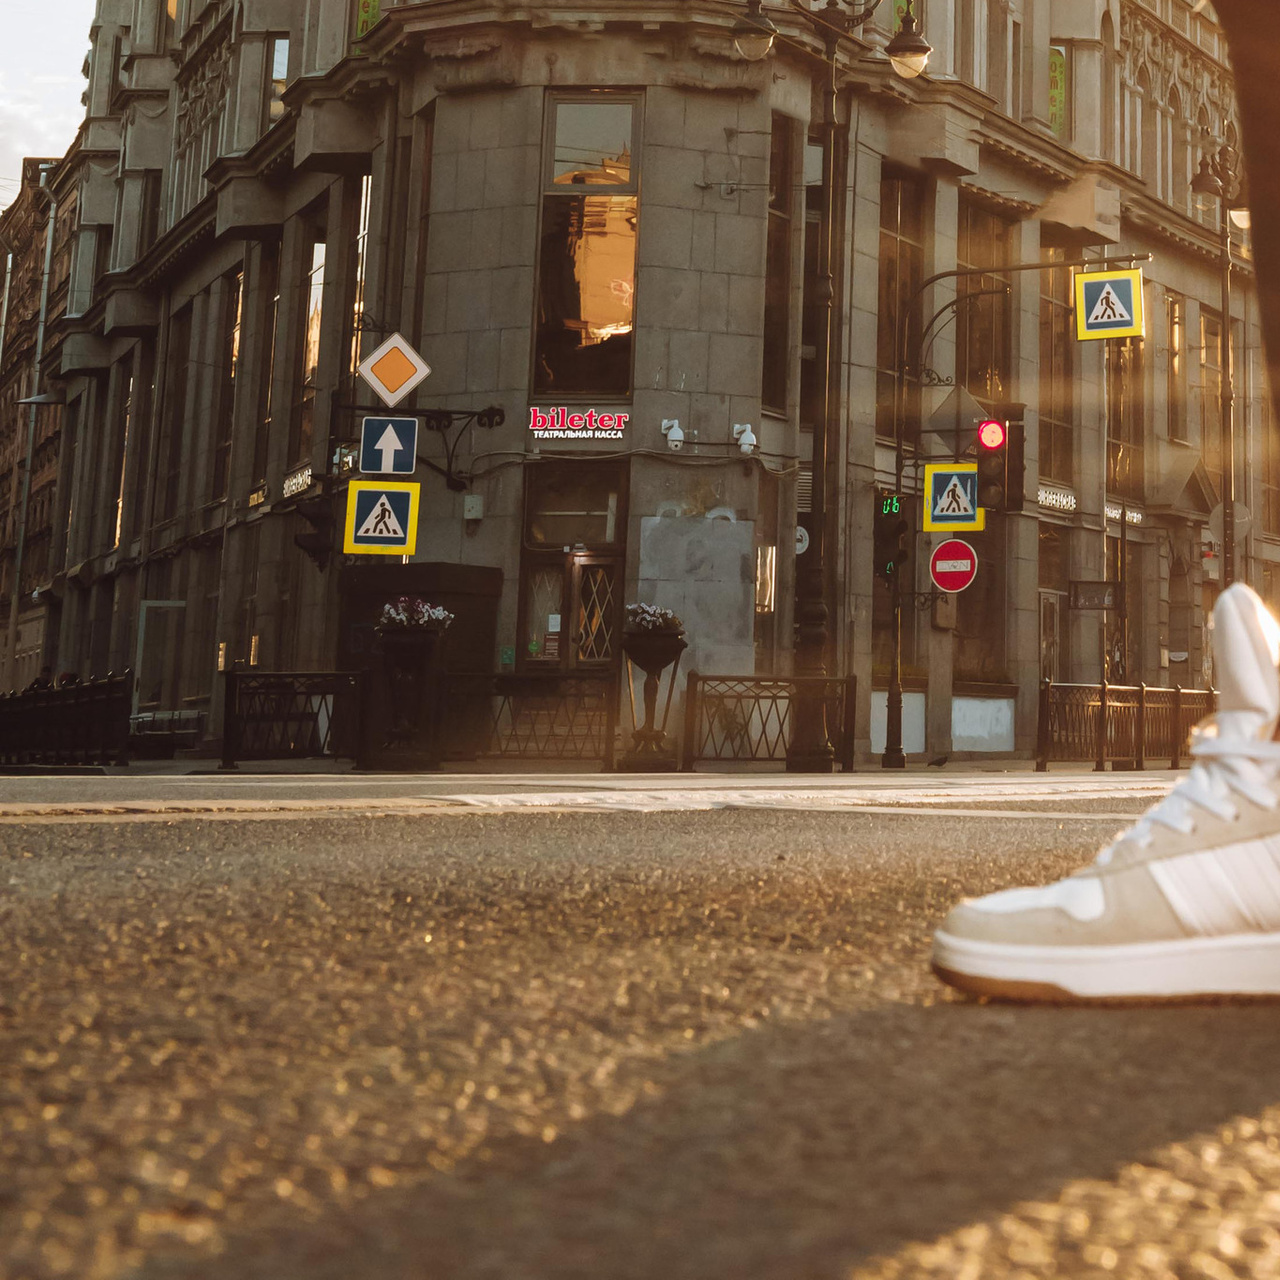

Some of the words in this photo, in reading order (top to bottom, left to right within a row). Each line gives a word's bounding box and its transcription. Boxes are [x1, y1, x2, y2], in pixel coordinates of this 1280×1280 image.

[529, 407, 629, 429] bileter
[533, 430, 593, 439] ТЕАТРАЛЬНАЯ
[595, 430, 623, 439] КАССА
